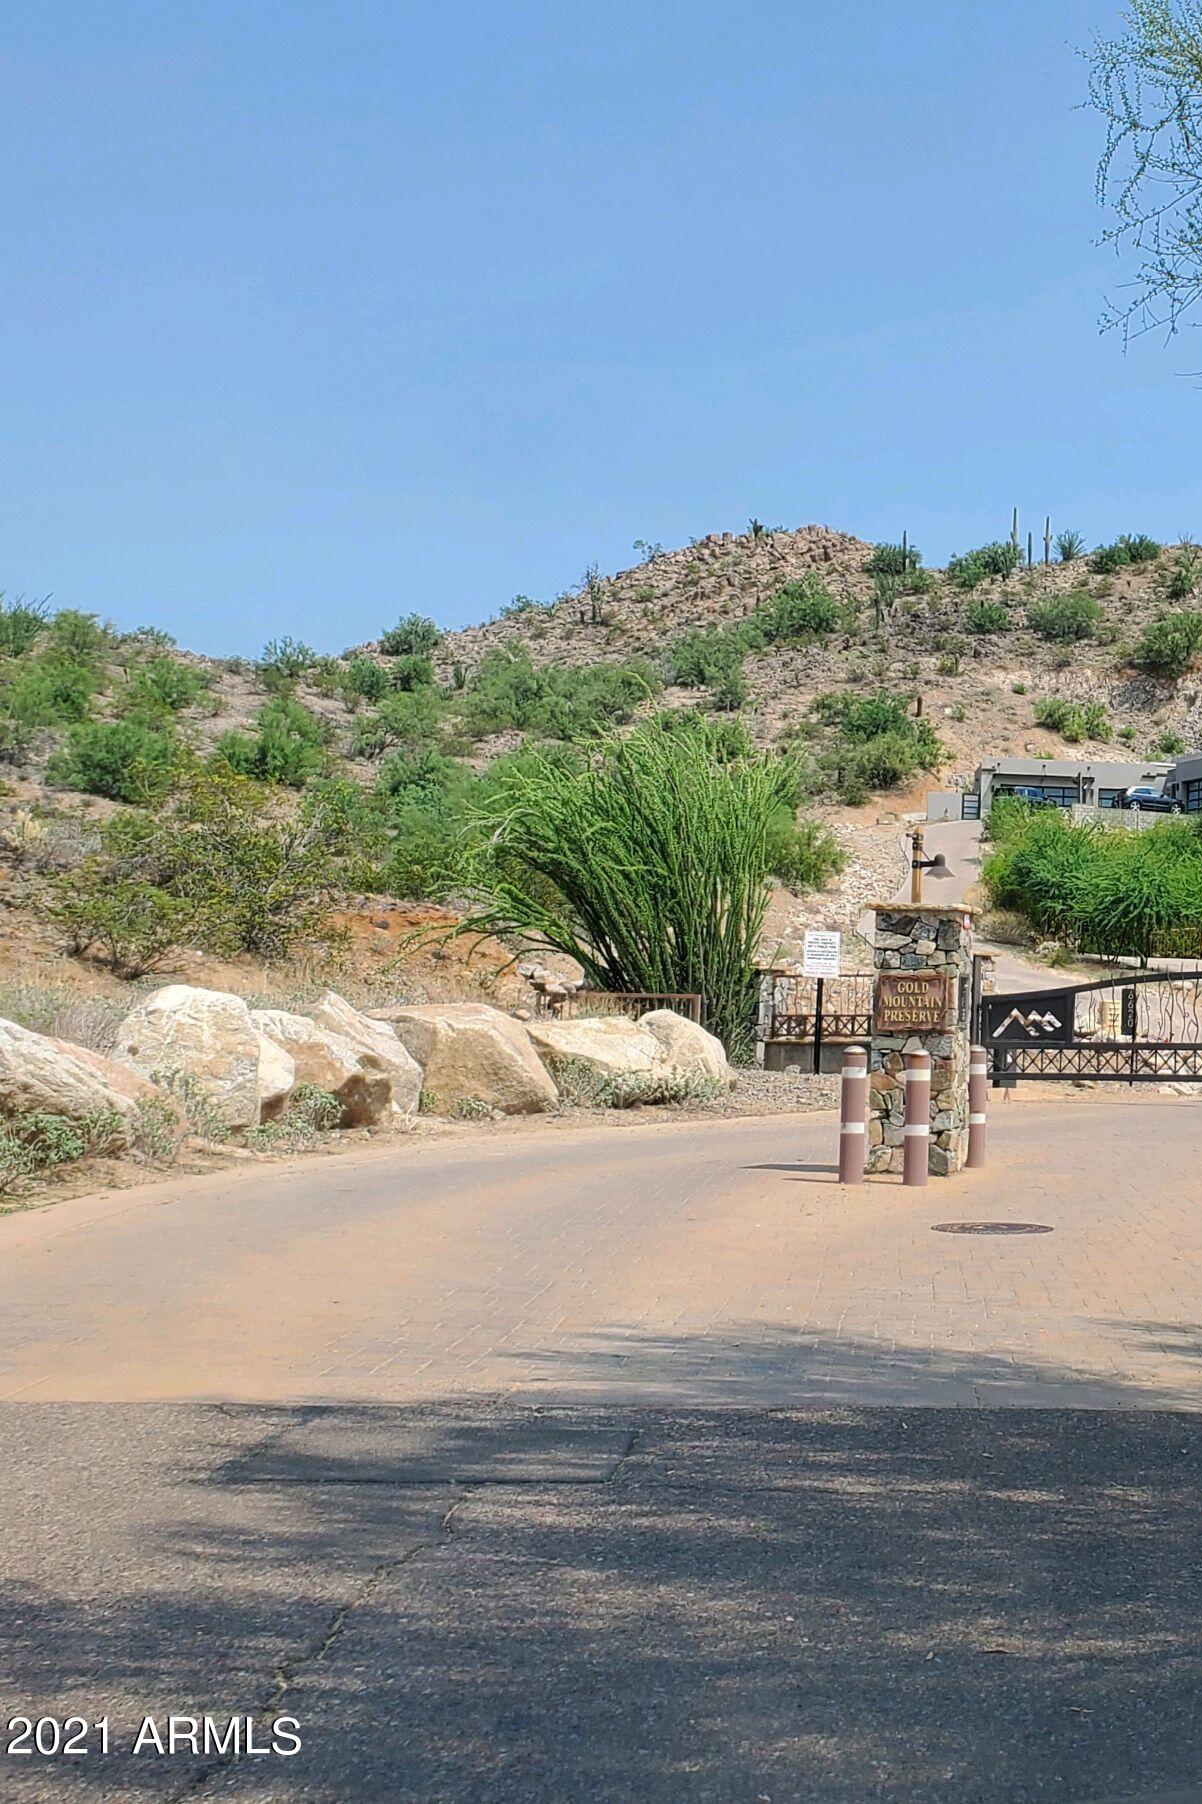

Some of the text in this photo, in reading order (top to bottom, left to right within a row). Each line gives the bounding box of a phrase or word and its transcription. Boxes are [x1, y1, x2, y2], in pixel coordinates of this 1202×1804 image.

[897, 981, 929, 993] GOLD
[883, 995, 942, 1008] MOUNTAIN
[884, 1010, 940, 1023] PRESERVE
